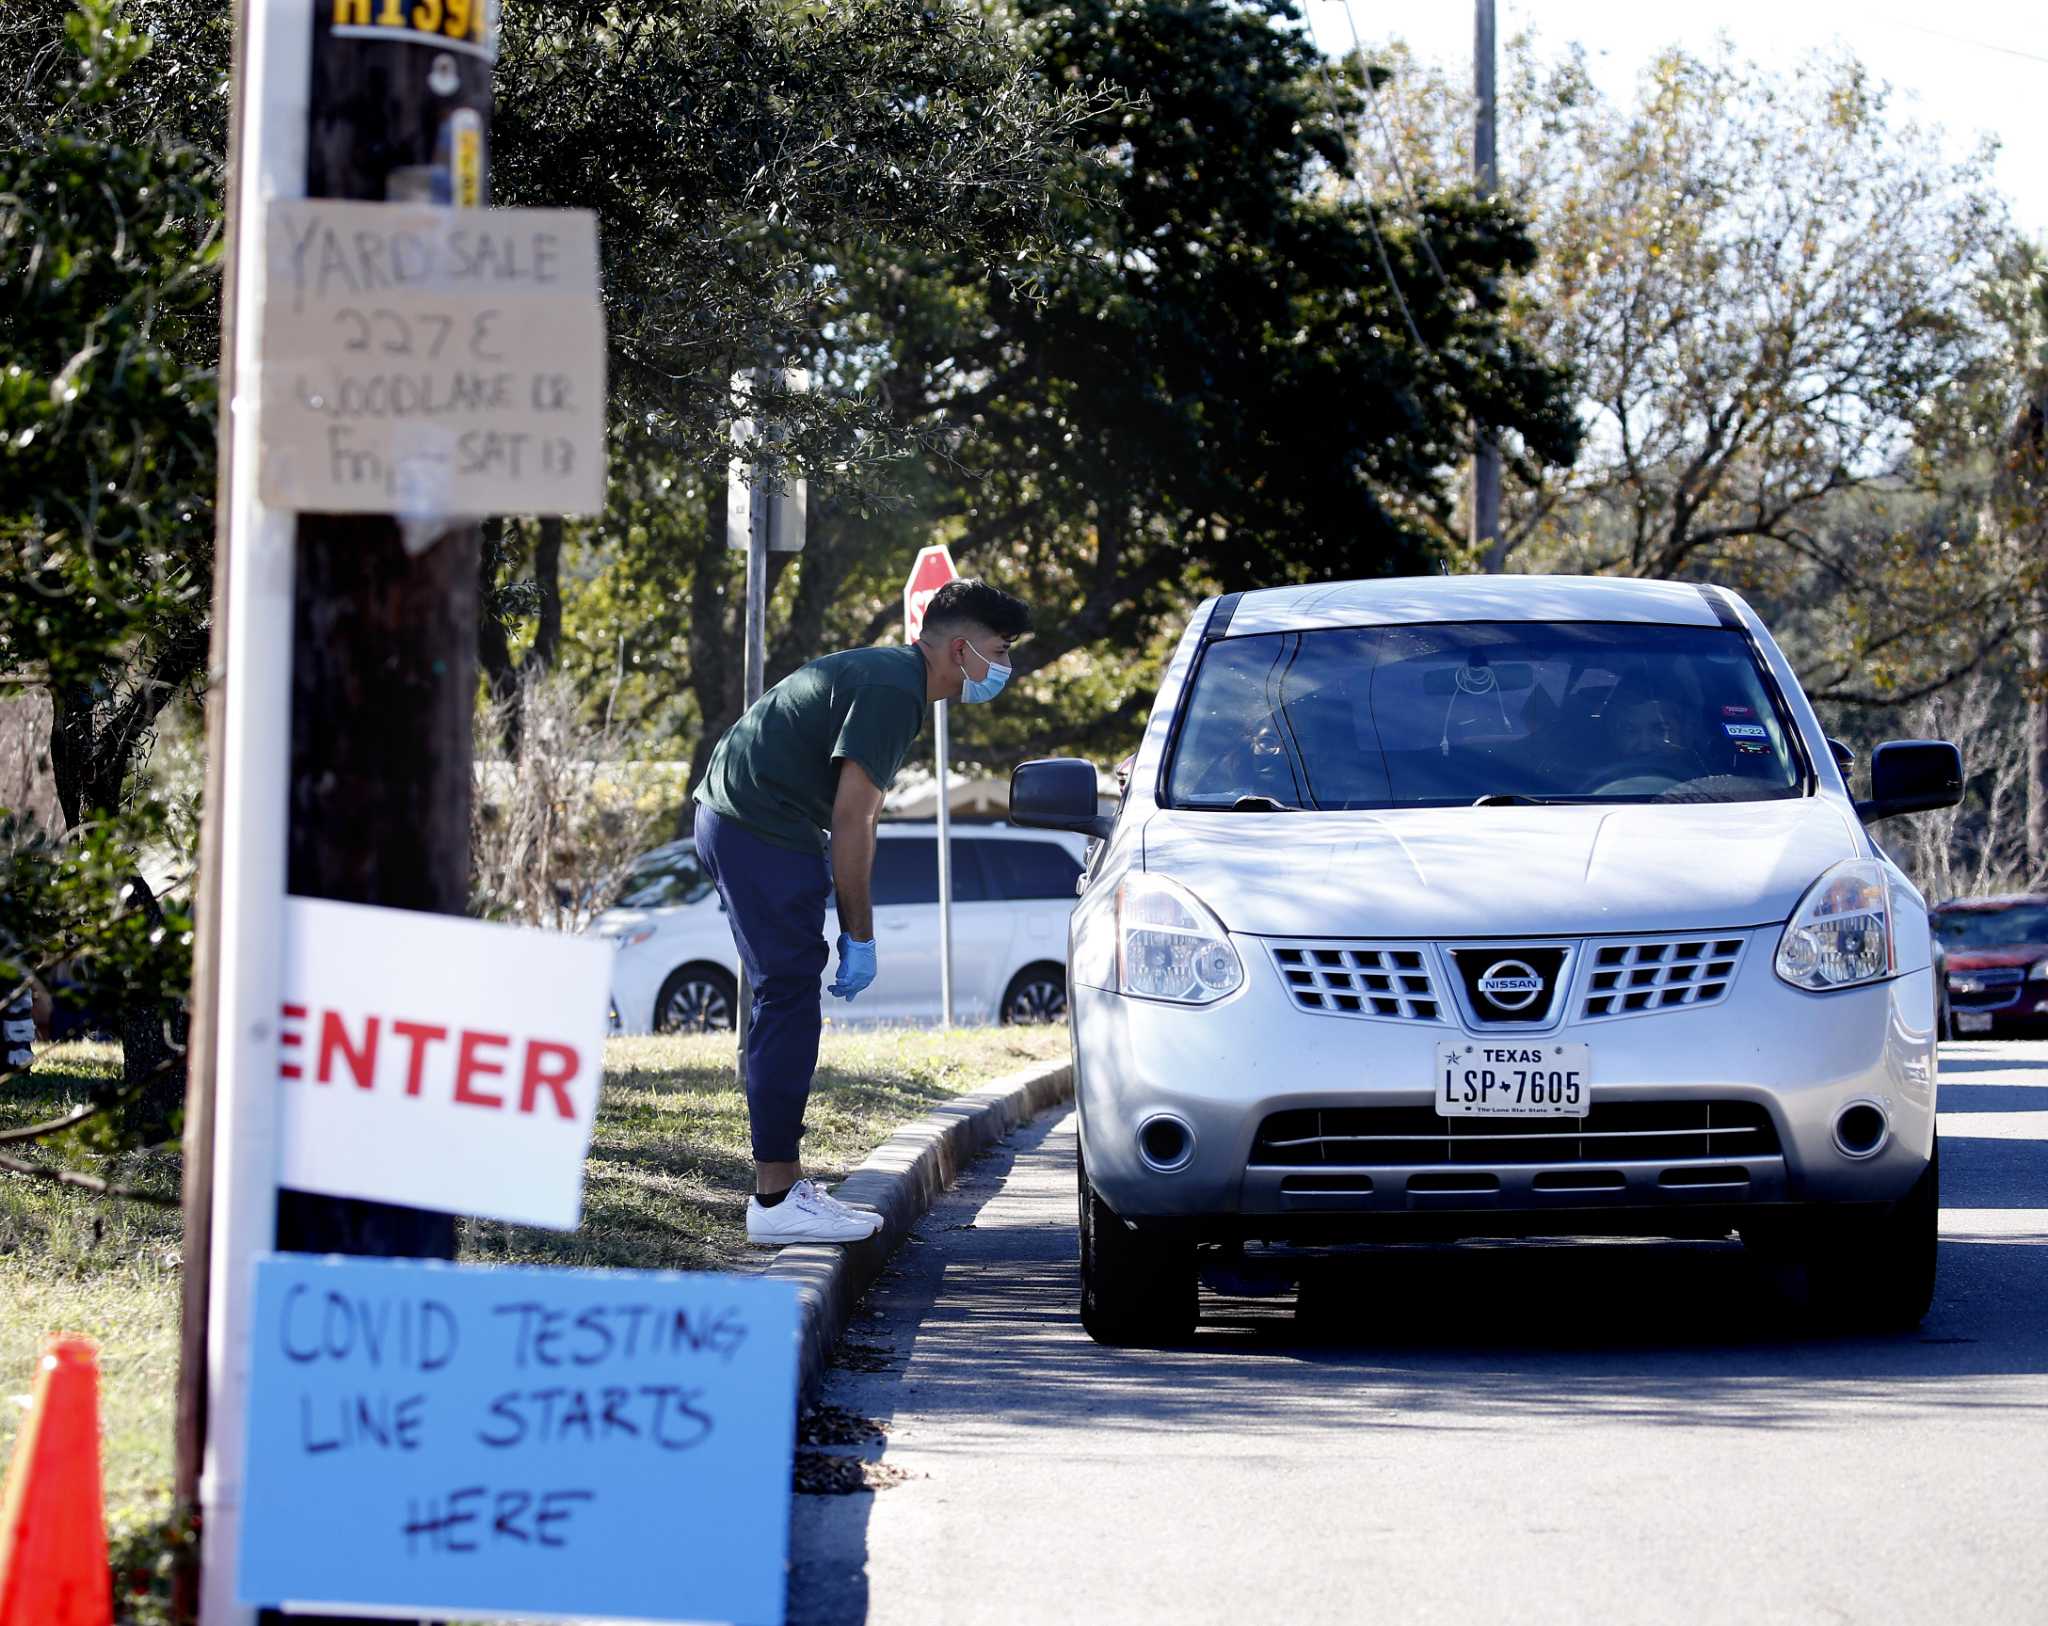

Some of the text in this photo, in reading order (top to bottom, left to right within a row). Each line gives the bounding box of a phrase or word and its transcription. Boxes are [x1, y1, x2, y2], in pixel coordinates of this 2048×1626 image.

[278, 212, 558, 314] YARD SALE
[333, 306, 454, 360] 227
[456, 430, 531, 478] SAT
[1485, 980, 1537, 989] NISSAN
[1483, 1049, 1543, 1063] TEXAS
[1446, 1069, 1580, 1104] LSP 7605
[279, 1282, 749, 1372] COVID TESTING
[303, 1384, 714, 1455] LINE STARTS
[402, 1485, 594, 1556] HERE
